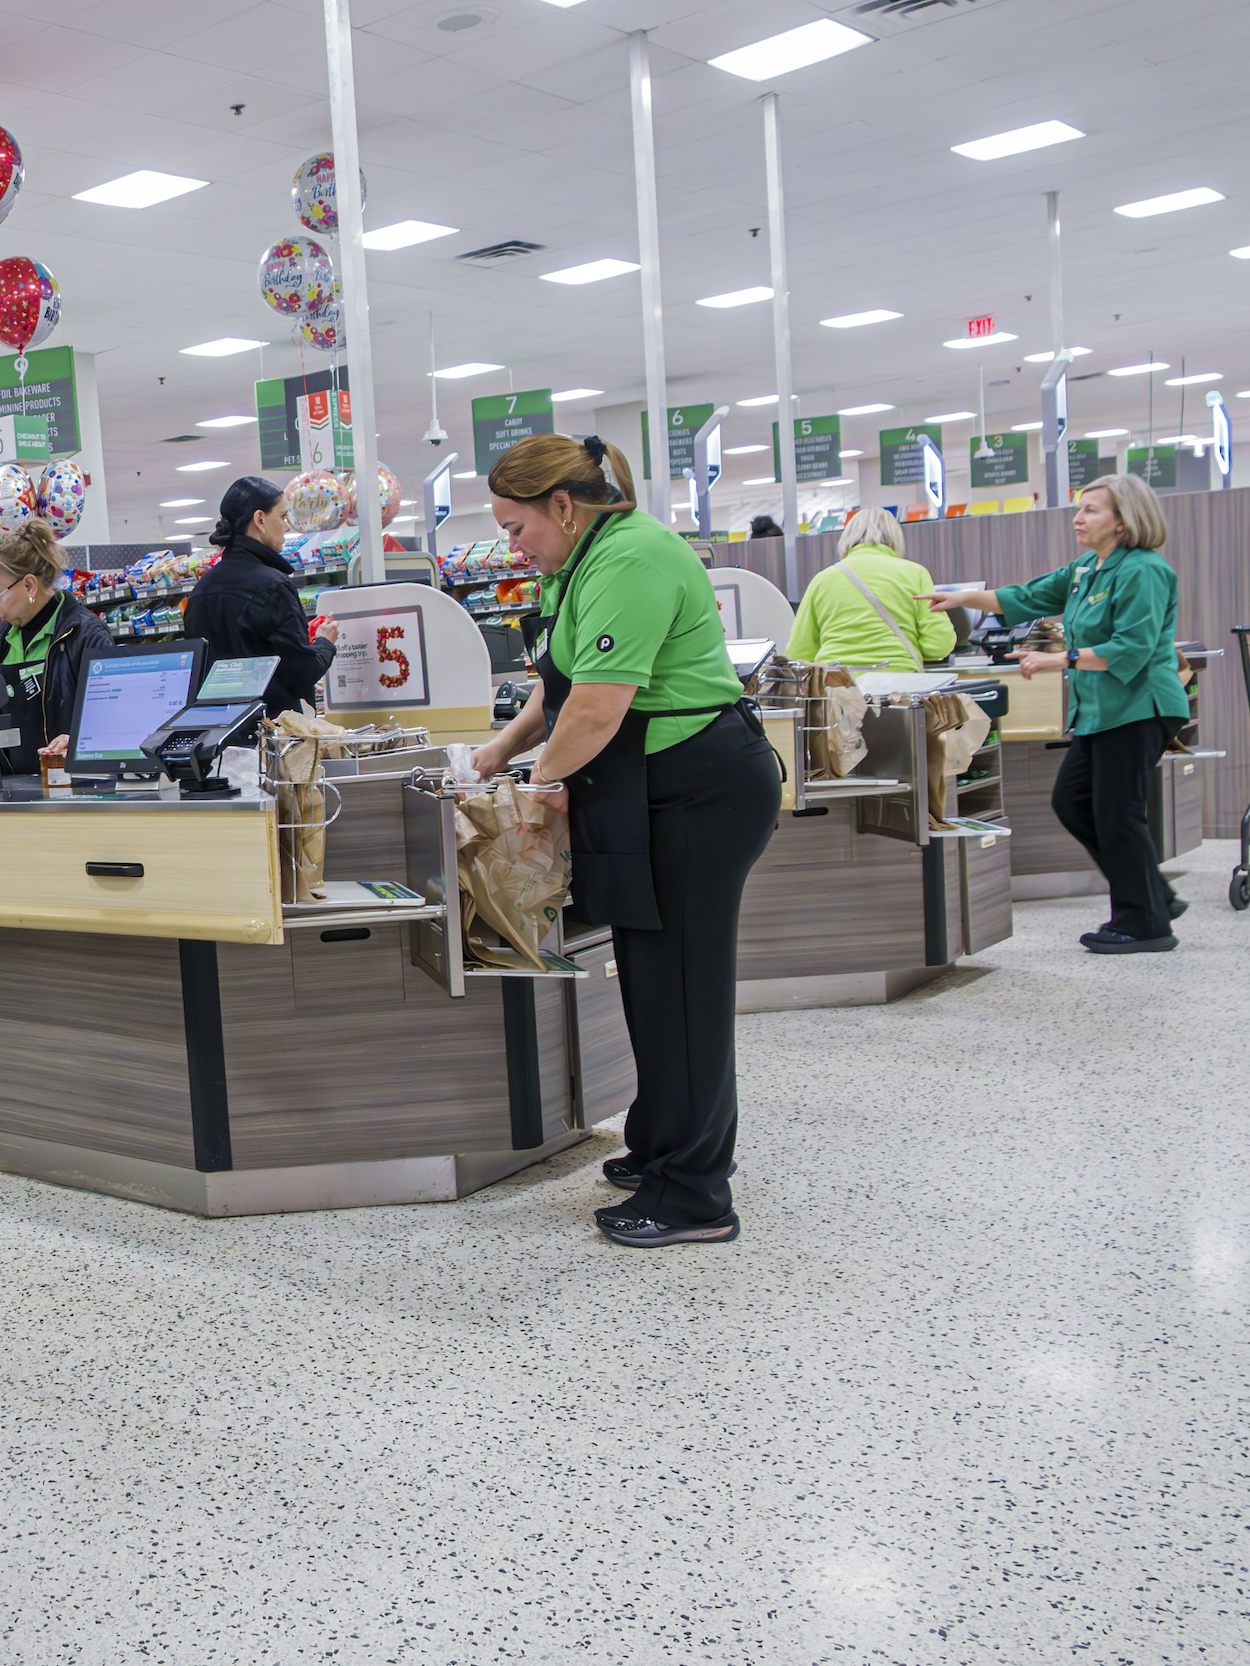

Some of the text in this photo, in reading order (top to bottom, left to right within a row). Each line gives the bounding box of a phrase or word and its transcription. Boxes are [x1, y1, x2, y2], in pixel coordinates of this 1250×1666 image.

[263, 269, 303, 289] Birthday
[968, 317, 993, 339] EXIT
[14, 357, 29, 380] 9
[13, 382, 51, 398] BAKEWARE
[25, 396, 62, 411] PRODUCTS
[504, 395, 518, 414] 7
[672, 409, 684, 425] 6
[495, 429, 510, 439] SOFT
[801, 420, 812, 435] 5
[905, 428, 916, 441] 4
[993, 435, 1004, 448] 3
[313, 442, 323, 464] 6
